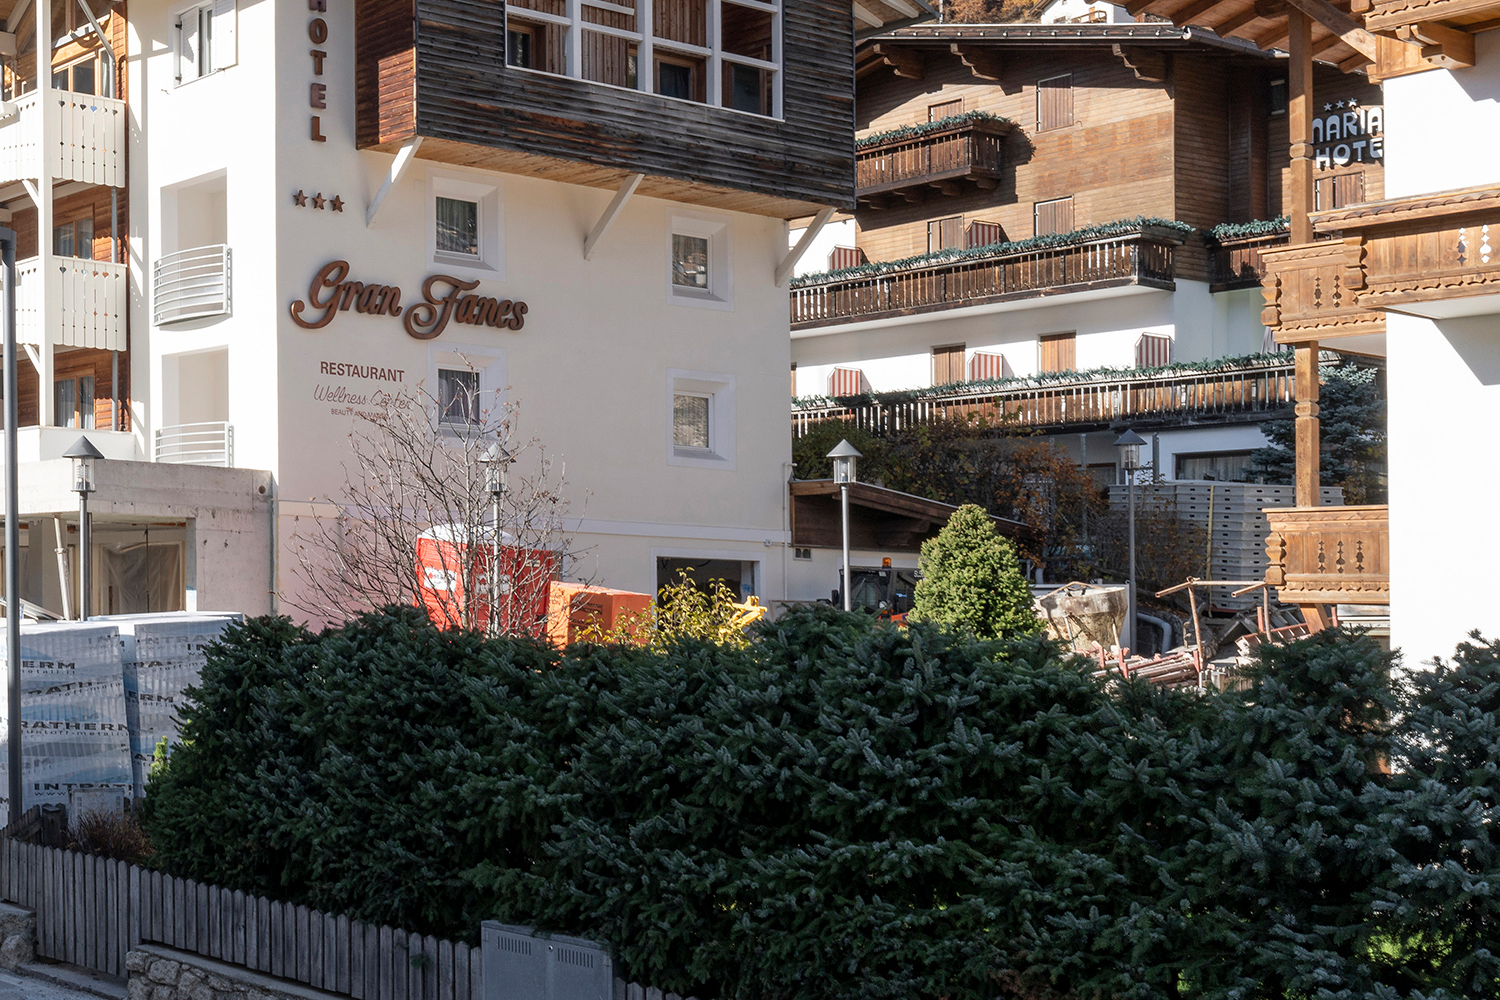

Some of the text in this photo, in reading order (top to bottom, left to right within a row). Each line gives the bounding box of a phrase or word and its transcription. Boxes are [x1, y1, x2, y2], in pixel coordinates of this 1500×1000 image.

[1315, 137, 1383, 169] HOTE
[290, 259, 529, 340] Gran Fanes
[320, 361, 405, 382] RESTAURANT
[313, 384, 367, 405] Wellness
